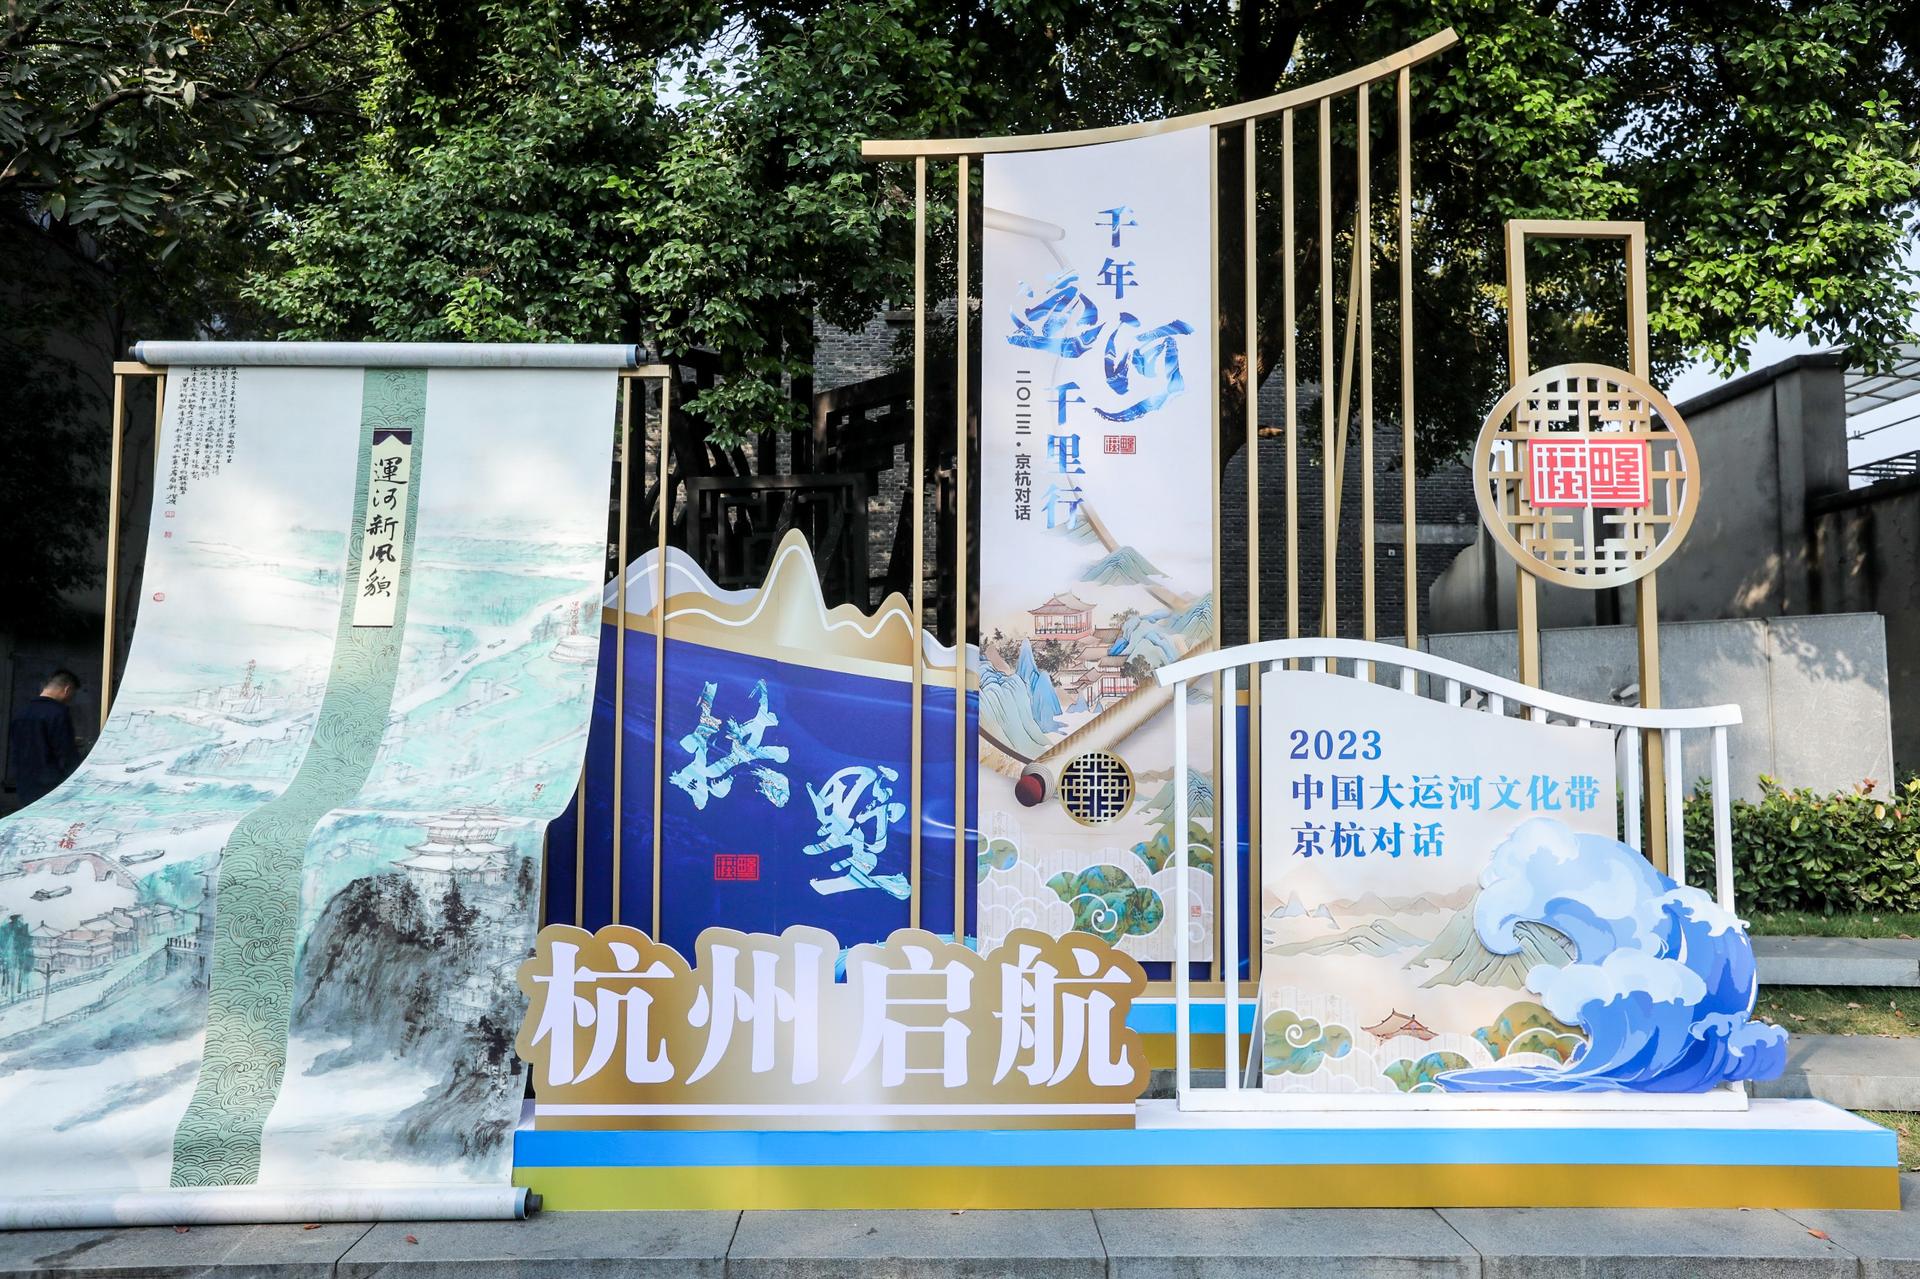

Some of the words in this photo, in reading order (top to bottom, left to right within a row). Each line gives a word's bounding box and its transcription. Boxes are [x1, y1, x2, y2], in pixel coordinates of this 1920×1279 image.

[1040, 381, 1086, 530] 千里行
[1290, 729, 1383, 760] 2023
[1292, 773, 1601, 812] 中国大运河文化带
[1290, 821, 1445, 859] 京杭对话
[531, 941, 1137, 1088] 杭州启航
